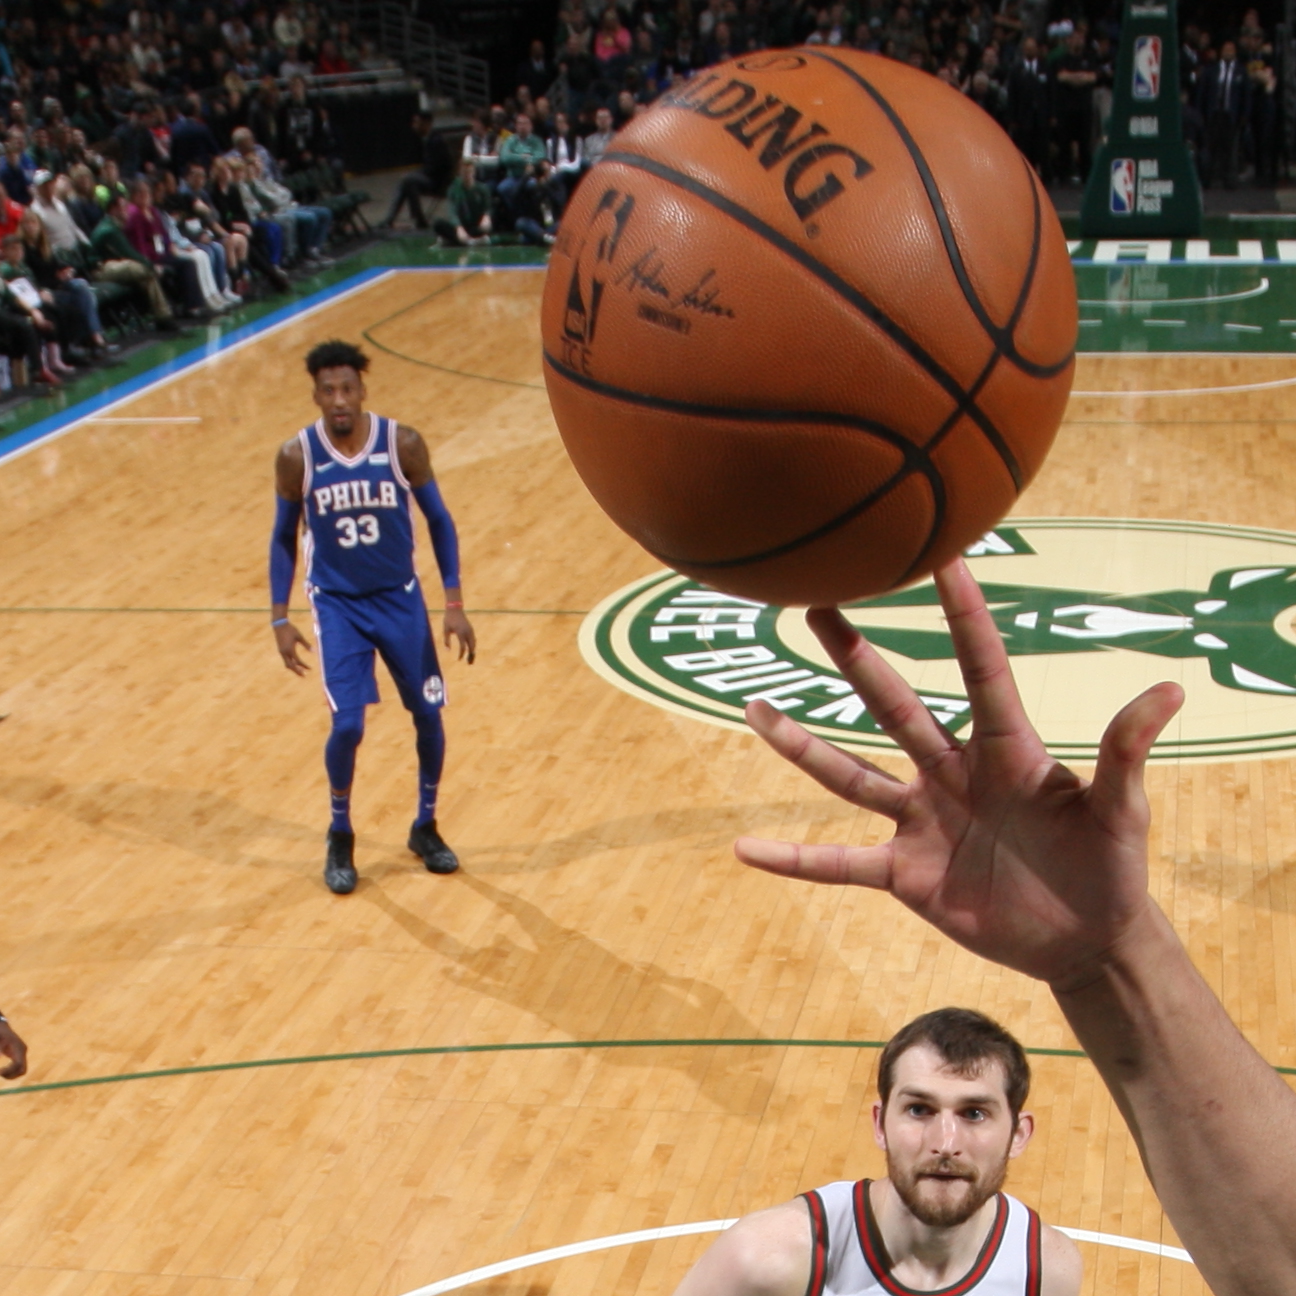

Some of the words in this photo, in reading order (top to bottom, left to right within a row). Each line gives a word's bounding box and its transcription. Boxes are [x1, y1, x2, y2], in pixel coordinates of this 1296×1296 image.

[659, 76, 876, 225] LDING
[314, 479, 399, 516] PHILA
[335, 514, 382, 549] 33
